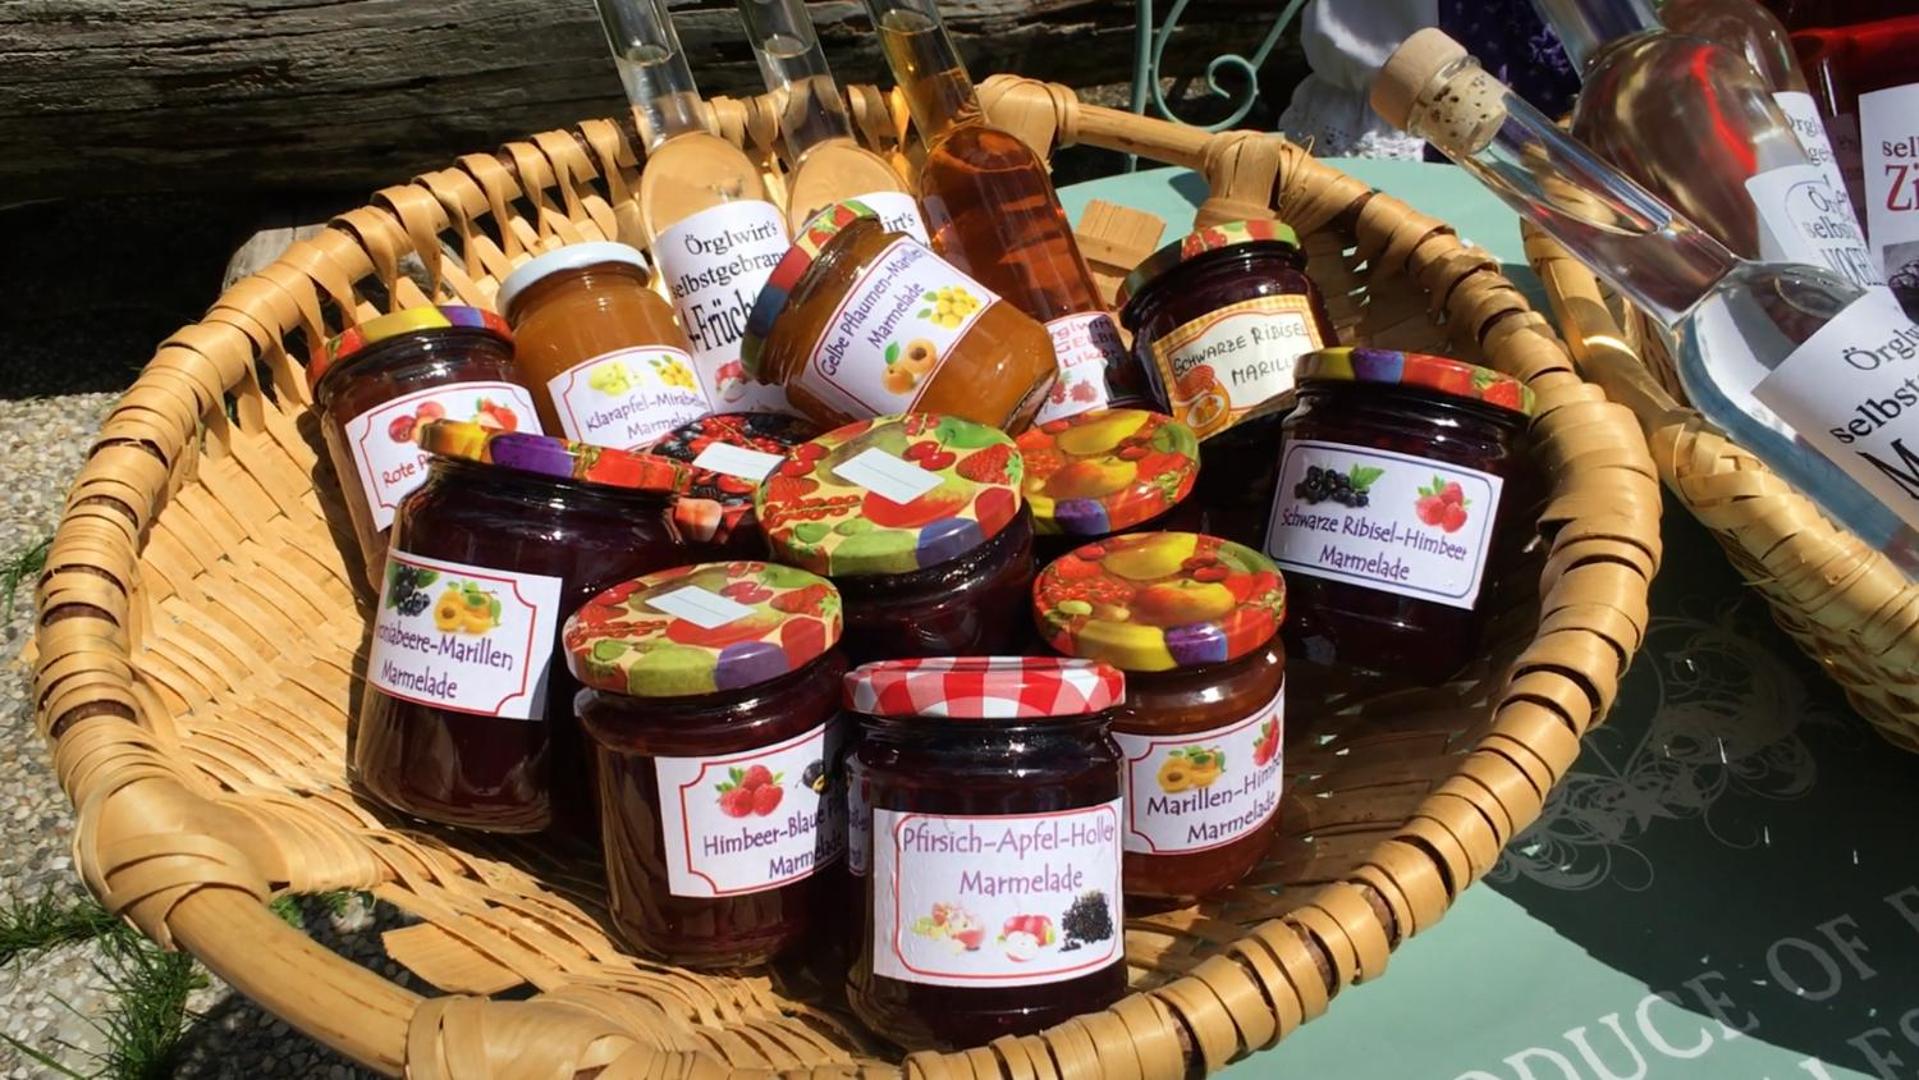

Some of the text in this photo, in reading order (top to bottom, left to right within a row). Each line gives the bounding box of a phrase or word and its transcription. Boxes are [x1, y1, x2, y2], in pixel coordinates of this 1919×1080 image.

[1882, 136, 1919, 158] sel
[867, 282, 925, 349] Marmelade
[821, 336, 850, 377] Gelbe
[1173, 336, 1247, 377] SCHWARZE
[1281, 505, 1339, 532] Schwarze
[1319, 544, 1410, 580] Marmelade
[381, 659, 458, 699] Marmelade
[960, 863, 1084, 896] Marmelade
[1766, 914, 1879, 1000] OF
